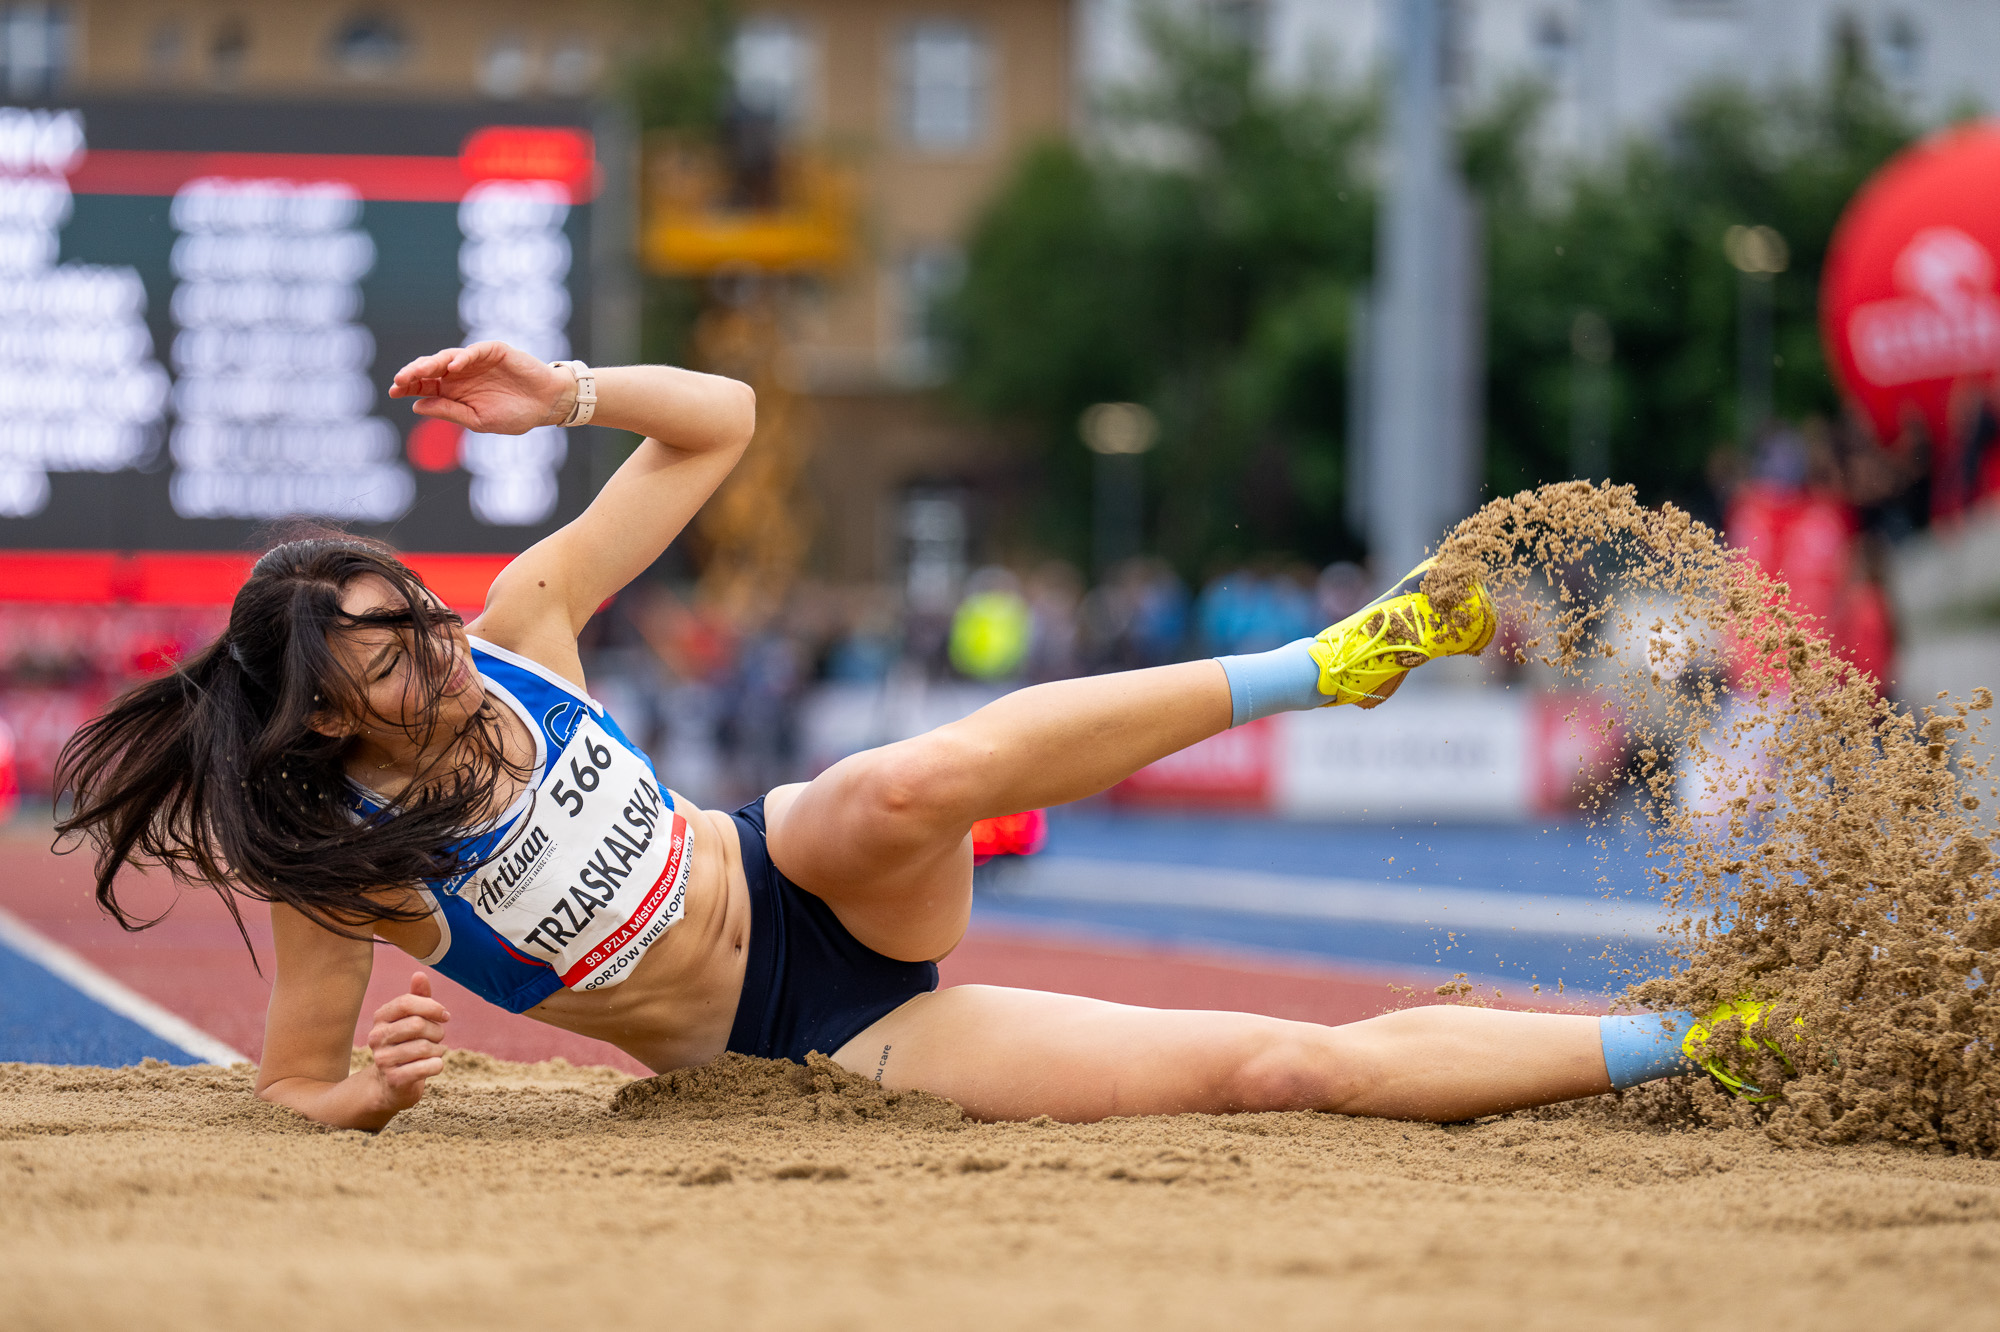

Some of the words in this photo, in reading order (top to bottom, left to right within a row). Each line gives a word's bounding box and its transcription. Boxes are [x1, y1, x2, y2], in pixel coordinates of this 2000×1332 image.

[550, 735, 612, 818] 566
[477, 826, 549, 915] Artisan
[524, 777, 661, 954] TRZASKALSKA
[585, 951, 606, 967] 99.
[603, 929, 632, 953] PZLA
[629, 867, 677, 931] Mistrzostwa
[670, 834, 683, 866] Polski
[585, 946, 640, 991] GORZÓW
[638, 862, 691, 948] WIELKOPOLSKI
[875, 1068, 884, 1082] ou
[879, 1044, 892, 1066] care
